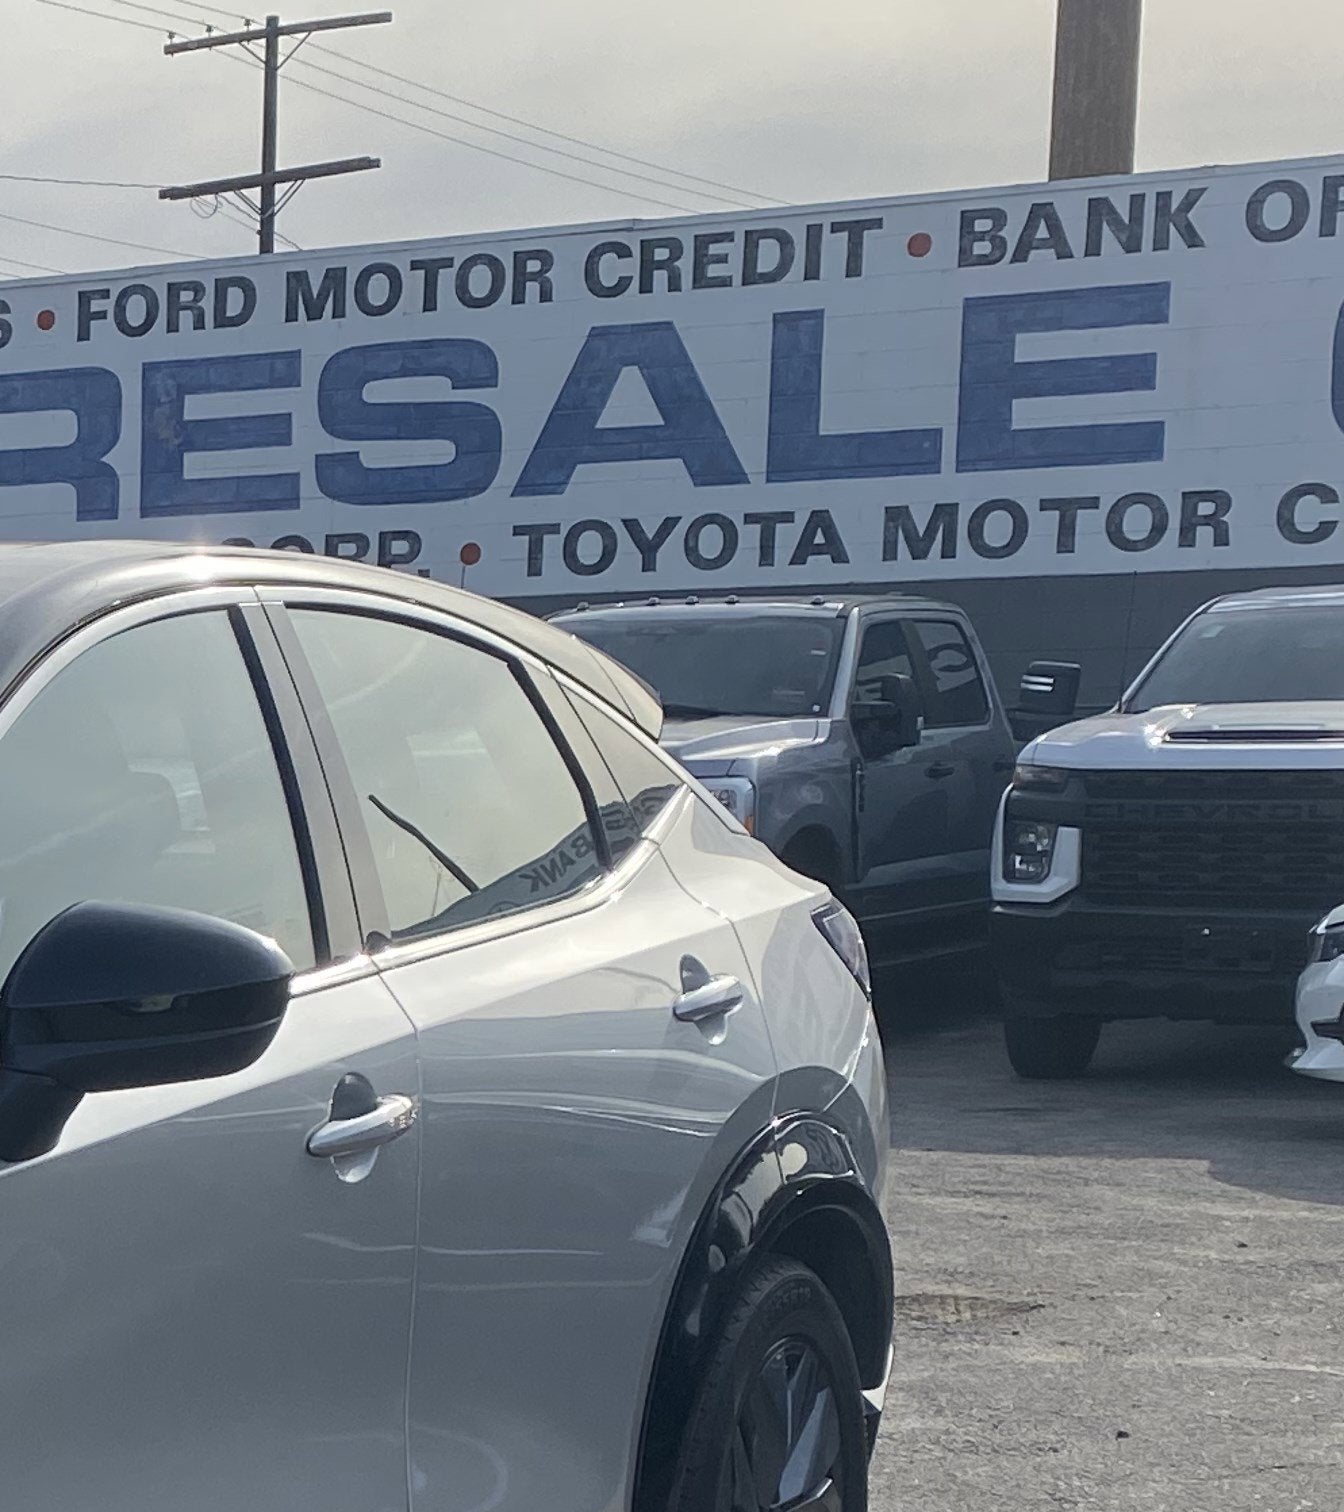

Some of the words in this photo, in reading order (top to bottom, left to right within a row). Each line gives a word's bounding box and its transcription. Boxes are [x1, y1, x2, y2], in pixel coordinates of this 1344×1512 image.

[76, 274, 258, 343] FORD
[284, 248, 555, 323] MOTOR
[584, 217, 884, 298] CREDIT
[958, 187, 1209, 268] BANK
[512, 509, 850, 578] TOYOTA
[883, 489, 1233, 562] MOTOR
